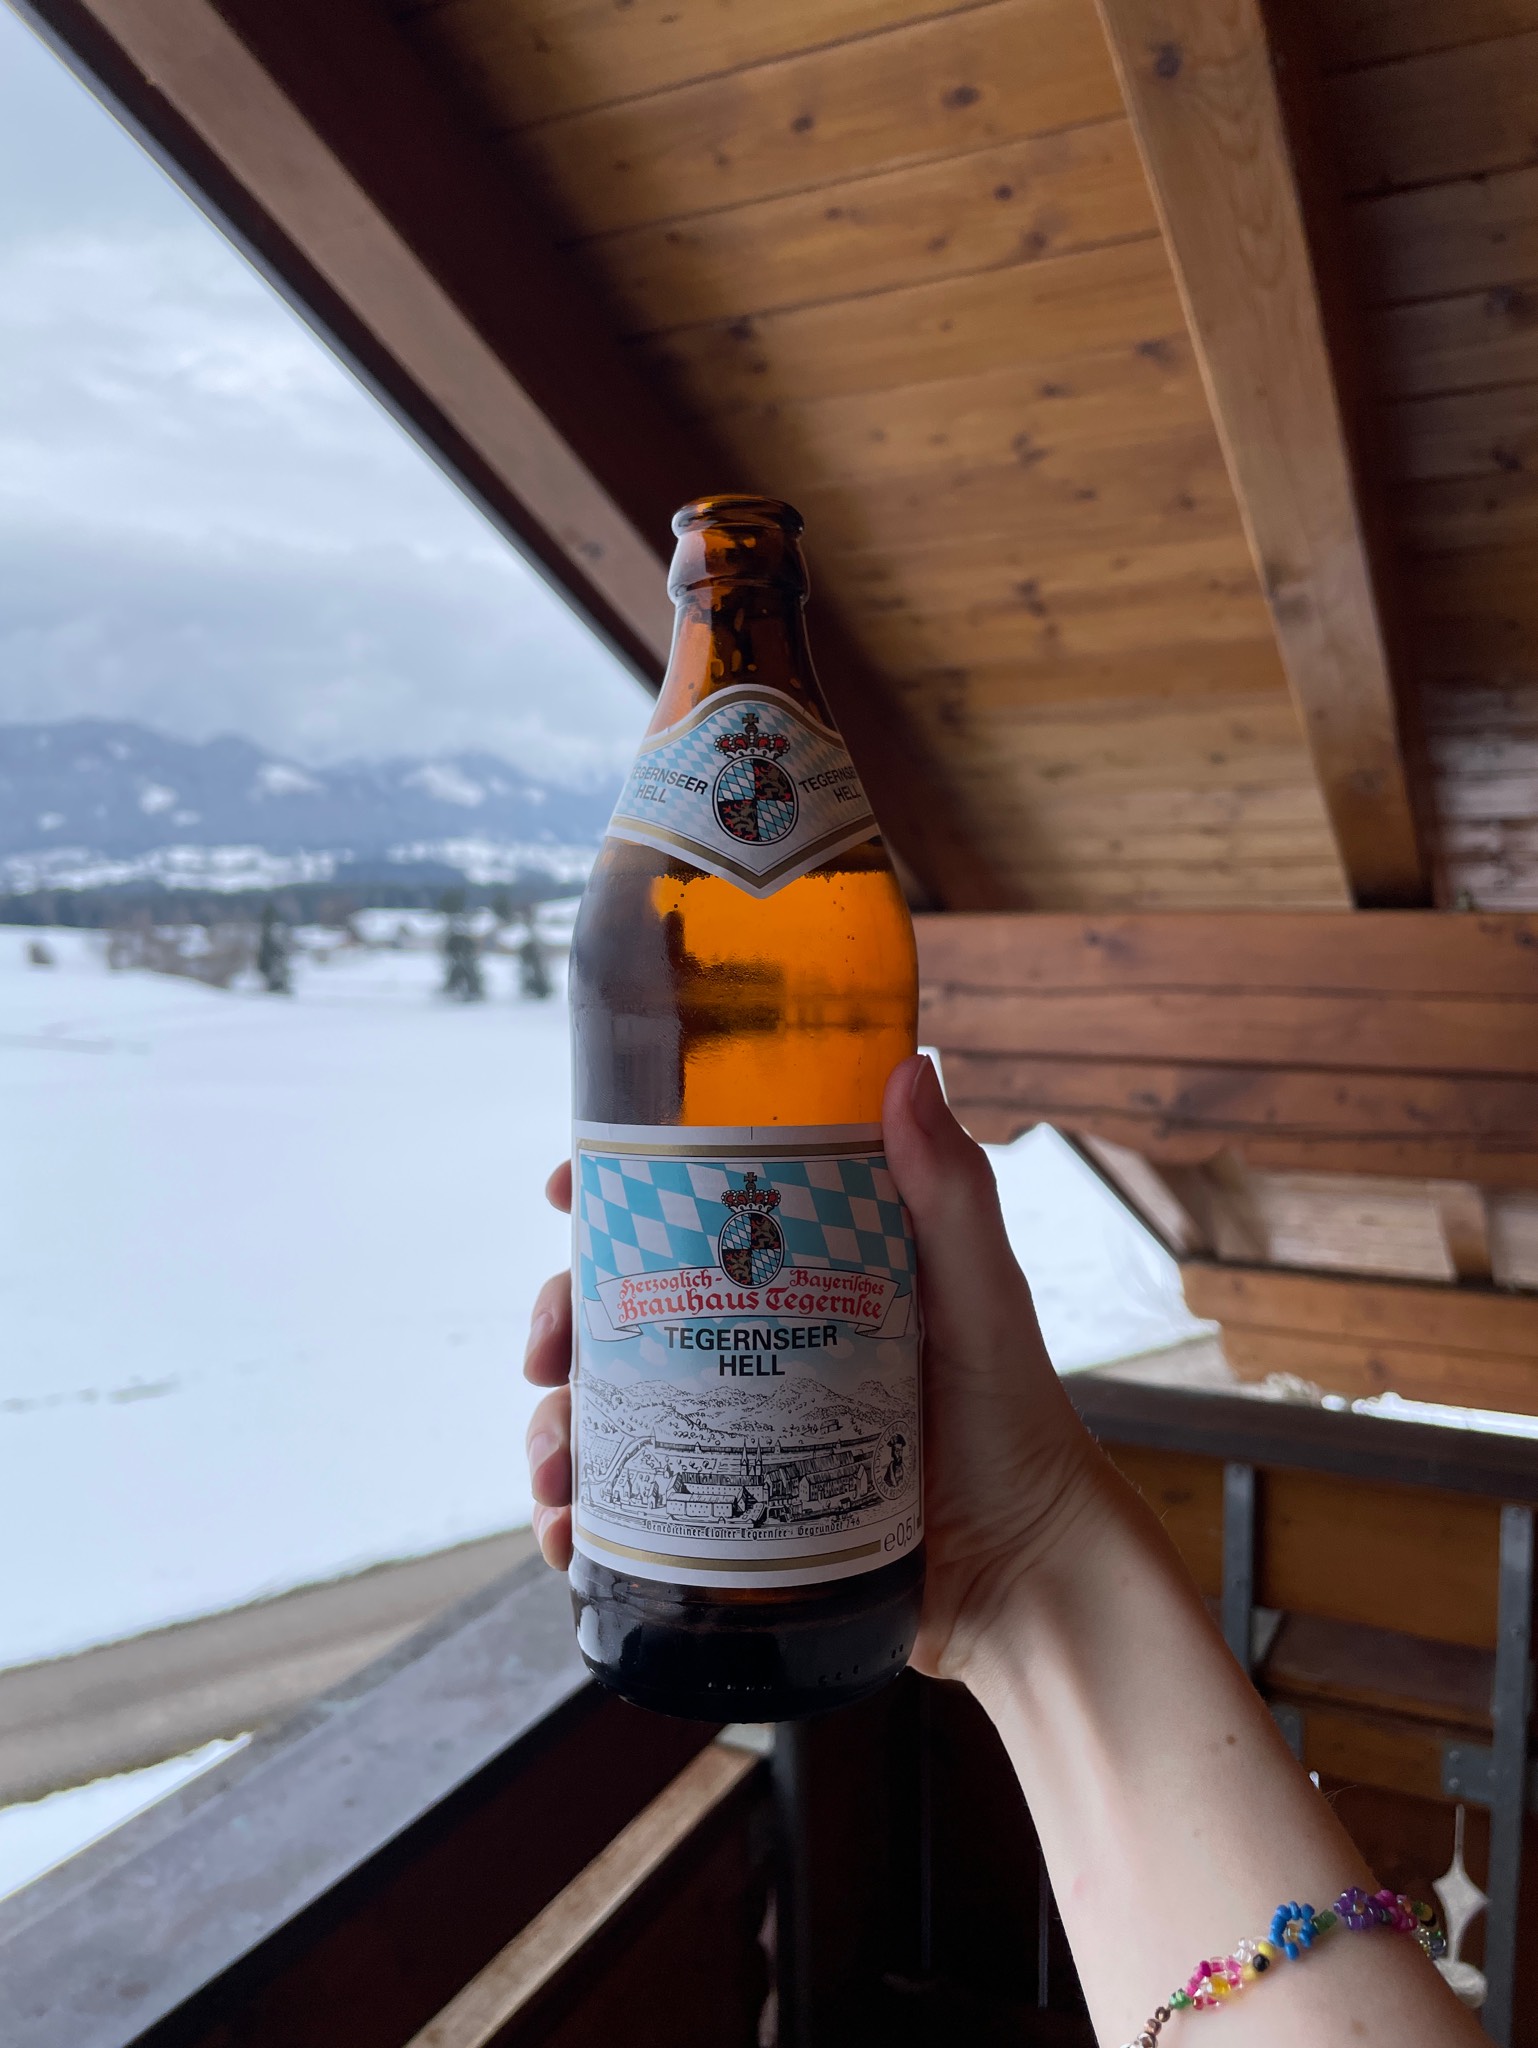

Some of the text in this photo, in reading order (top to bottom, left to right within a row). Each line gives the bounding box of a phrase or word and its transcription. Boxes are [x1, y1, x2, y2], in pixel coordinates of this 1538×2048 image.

[635, 784, 666, 804] HELL
[833, 784, 861, 803] HELL
[617, 1288, 760, 1323] Brauhaus
[664, 1325, 838, 1351] TEGERNSEER
[719, 1354, 786, 1377] HELL
